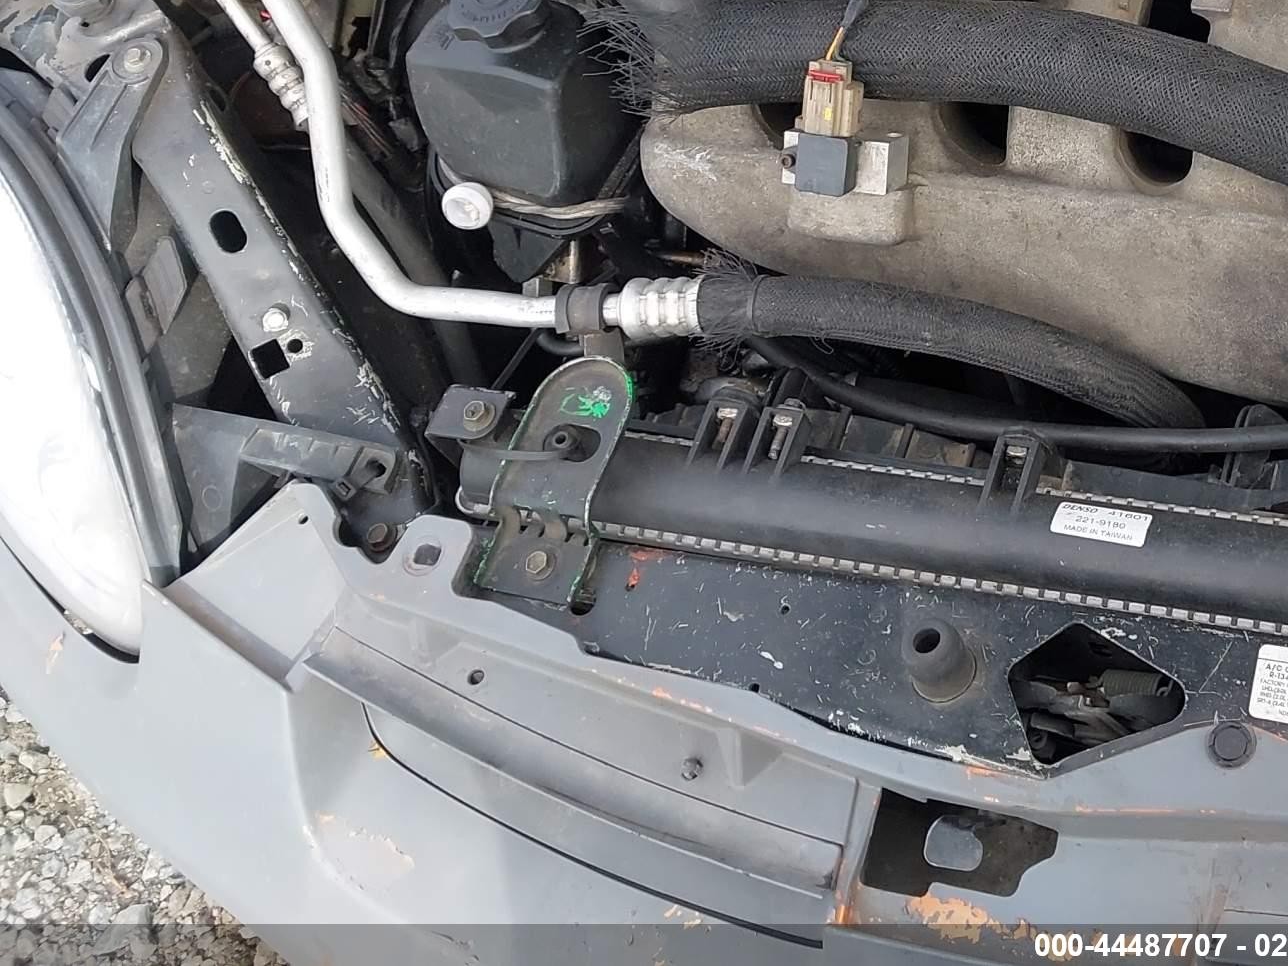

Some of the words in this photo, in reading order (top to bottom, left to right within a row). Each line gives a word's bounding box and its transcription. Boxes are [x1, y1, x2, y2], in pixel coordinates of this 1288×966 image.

[1061, 502, 1099, 514] DENSO
[1074, 515, 1127, 530] 221-9180
[1063, 523, 1089, 534] MADE
[1089, 528, 1099, 536] IN
[1099, 529, 1134, 542] TAIWAN
[1265, 662, 1283, 672] A/C
